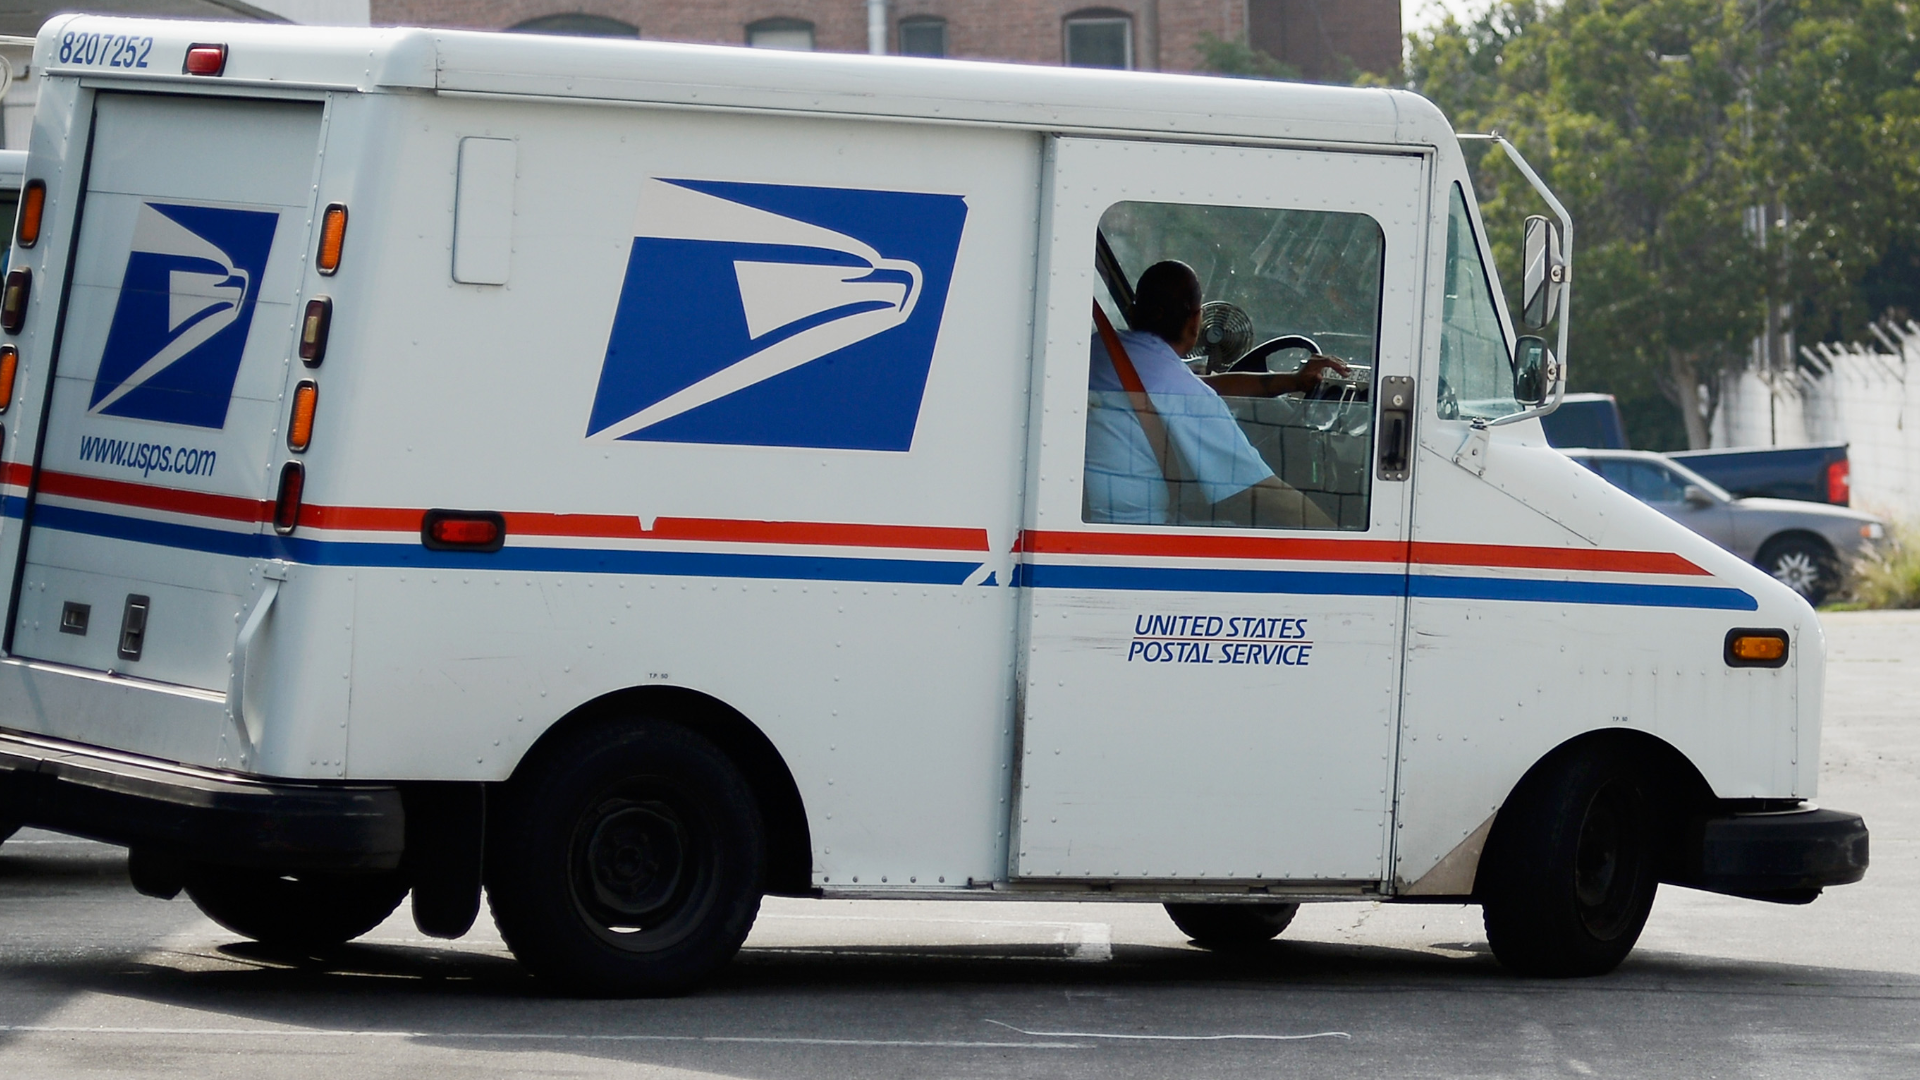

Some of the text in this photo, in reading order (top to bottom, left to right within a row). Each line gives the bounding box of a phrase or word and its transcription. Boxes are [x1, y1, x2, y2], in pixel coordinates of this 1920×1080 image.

[59, 31, 153, 68] 8207252
[79, 435, 216, 478] www.usps.com
[1135, 615, 1307, 638] UNITED STATES
[1128, 641, 1312, 666] POSTAL SERVICE
